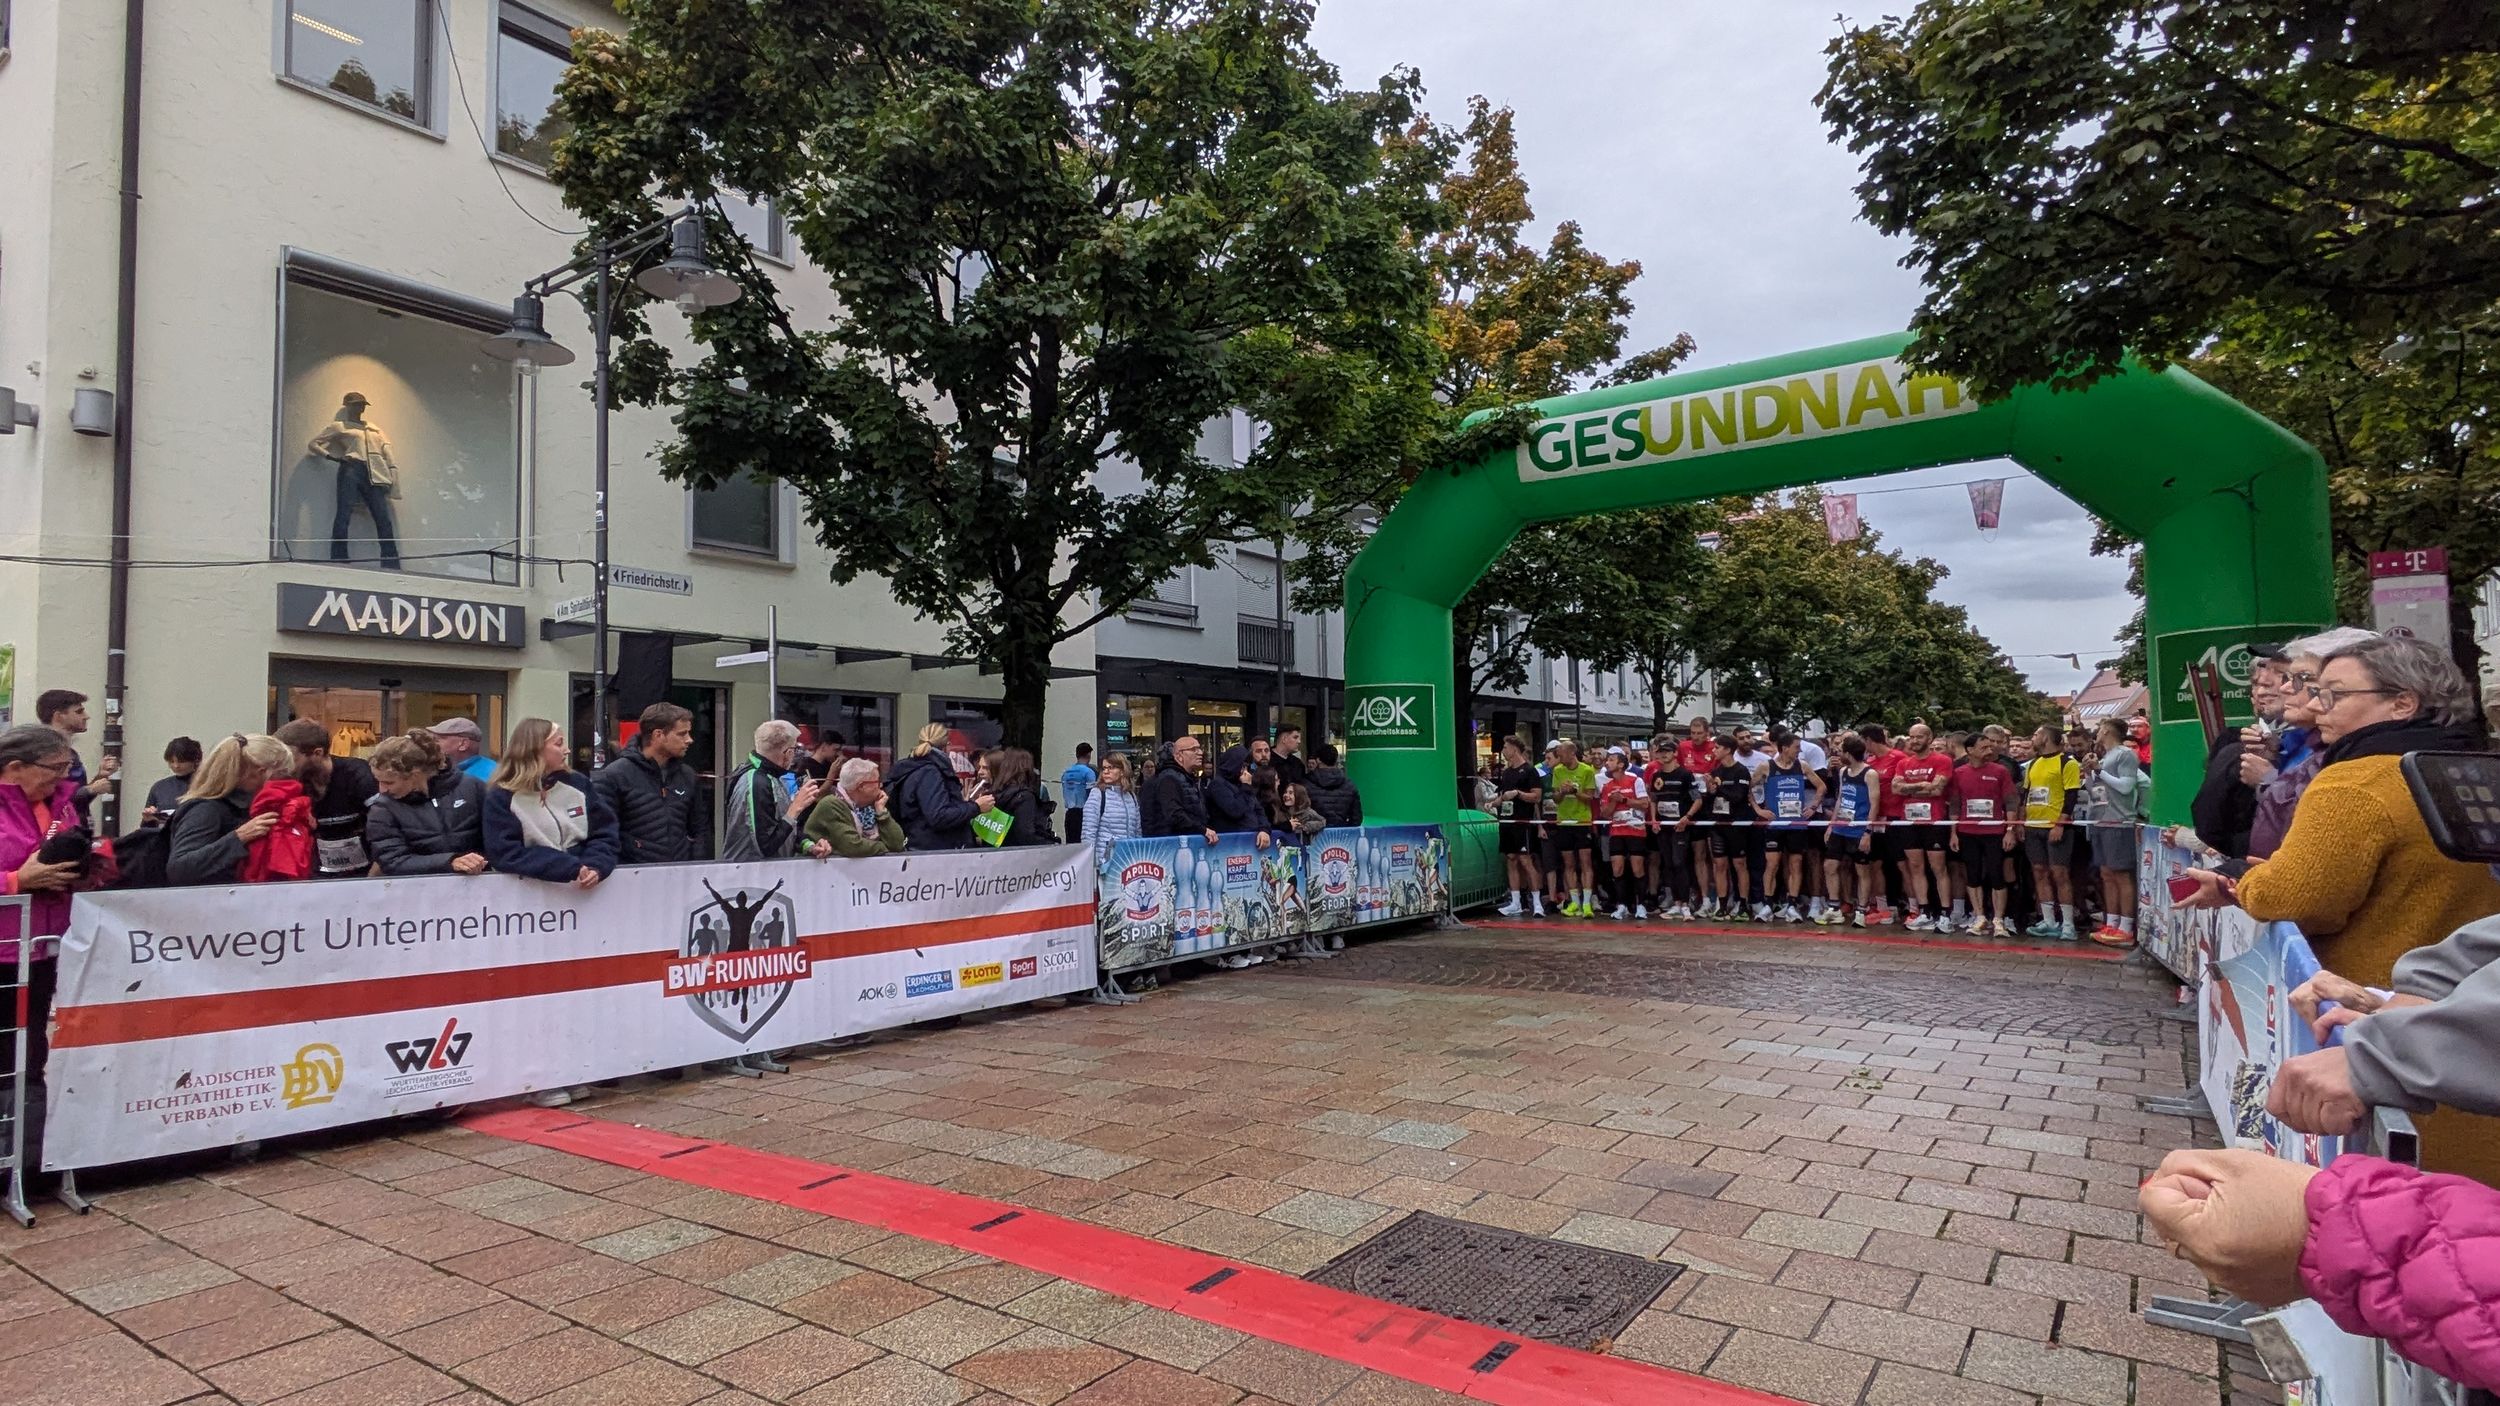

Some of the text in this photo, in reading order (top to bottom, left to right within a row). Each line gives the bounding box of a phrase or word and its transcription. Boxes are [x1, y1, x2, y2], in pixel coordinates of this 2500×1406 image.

[620, 569, 682, 591] Friedrichstr.
[1350, 695, 1418, 728] AOK
[1323, 848, 1348, 862] APOLLO
[1125, 863, 1160, 882] APOLLO
[851, 865, 1078, 907] in Baden-Württemberg!
[1321, 897, 1351, 911] SPORT
[127, 906, 578, 967] Bewegt Unternehmen
[1121, 922, 1168, 943] SPORT
[667, 950, 807, 990] BW-RUNNING
[906, 973, 944, 987] ERDINGER
[972, 965, 1001, 979] LOTTO
[858, 986, 885, 1002] AOK
[182, 1065, 277, 1090] BADISCHER
[124, 1081, 278, 1114] LEICHTATHLETIK-
[160, 1097, 277, 1126] VERBAND E.V.
